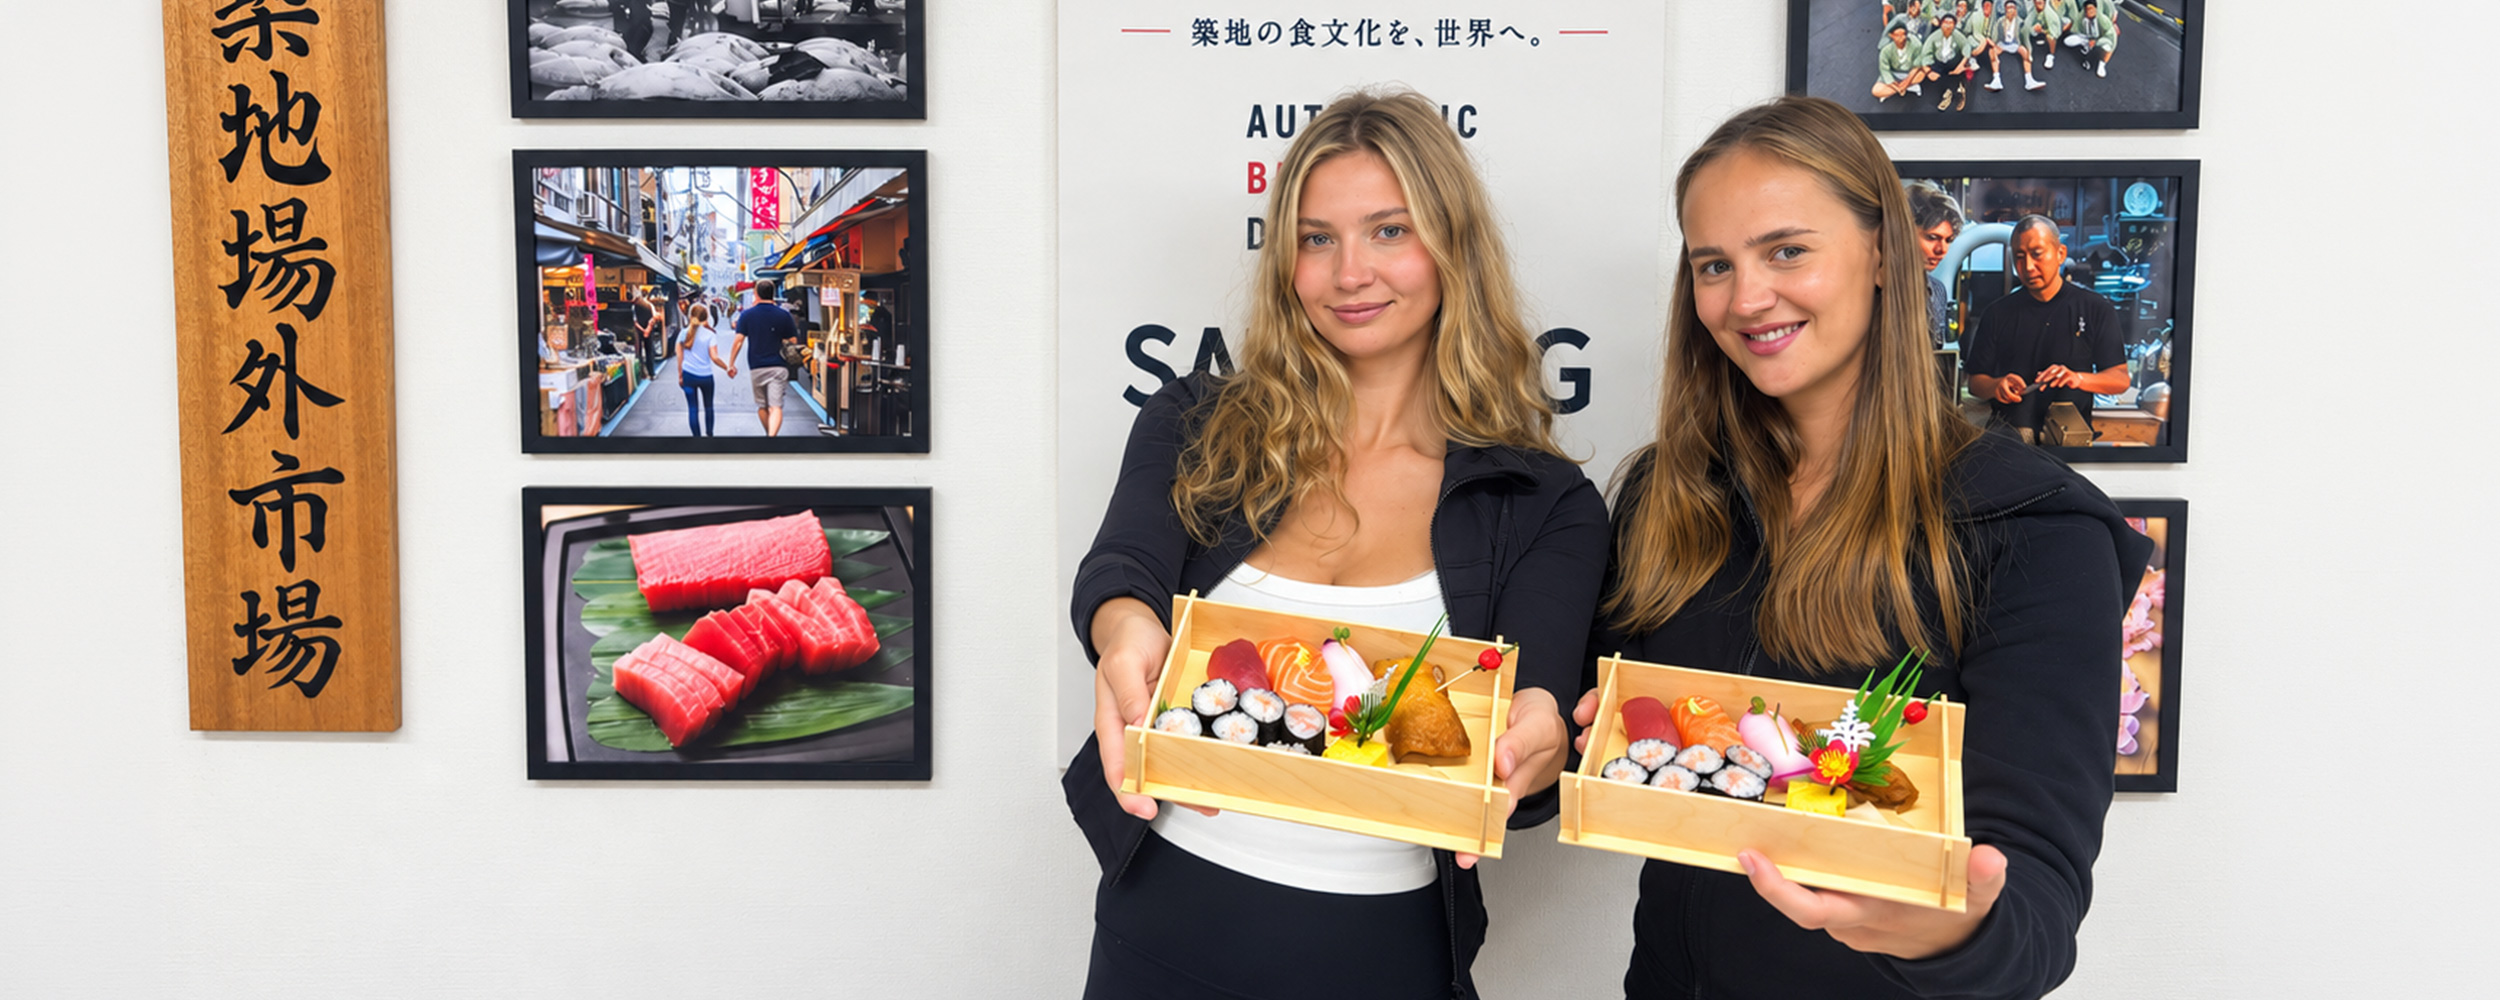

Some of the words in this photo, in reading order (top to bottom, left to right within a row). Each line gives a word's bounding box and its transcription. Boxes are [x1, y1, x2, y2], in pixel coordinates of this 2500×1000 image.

[1191, 17, 1541, 48] 築地の食文化を、世界へ。
